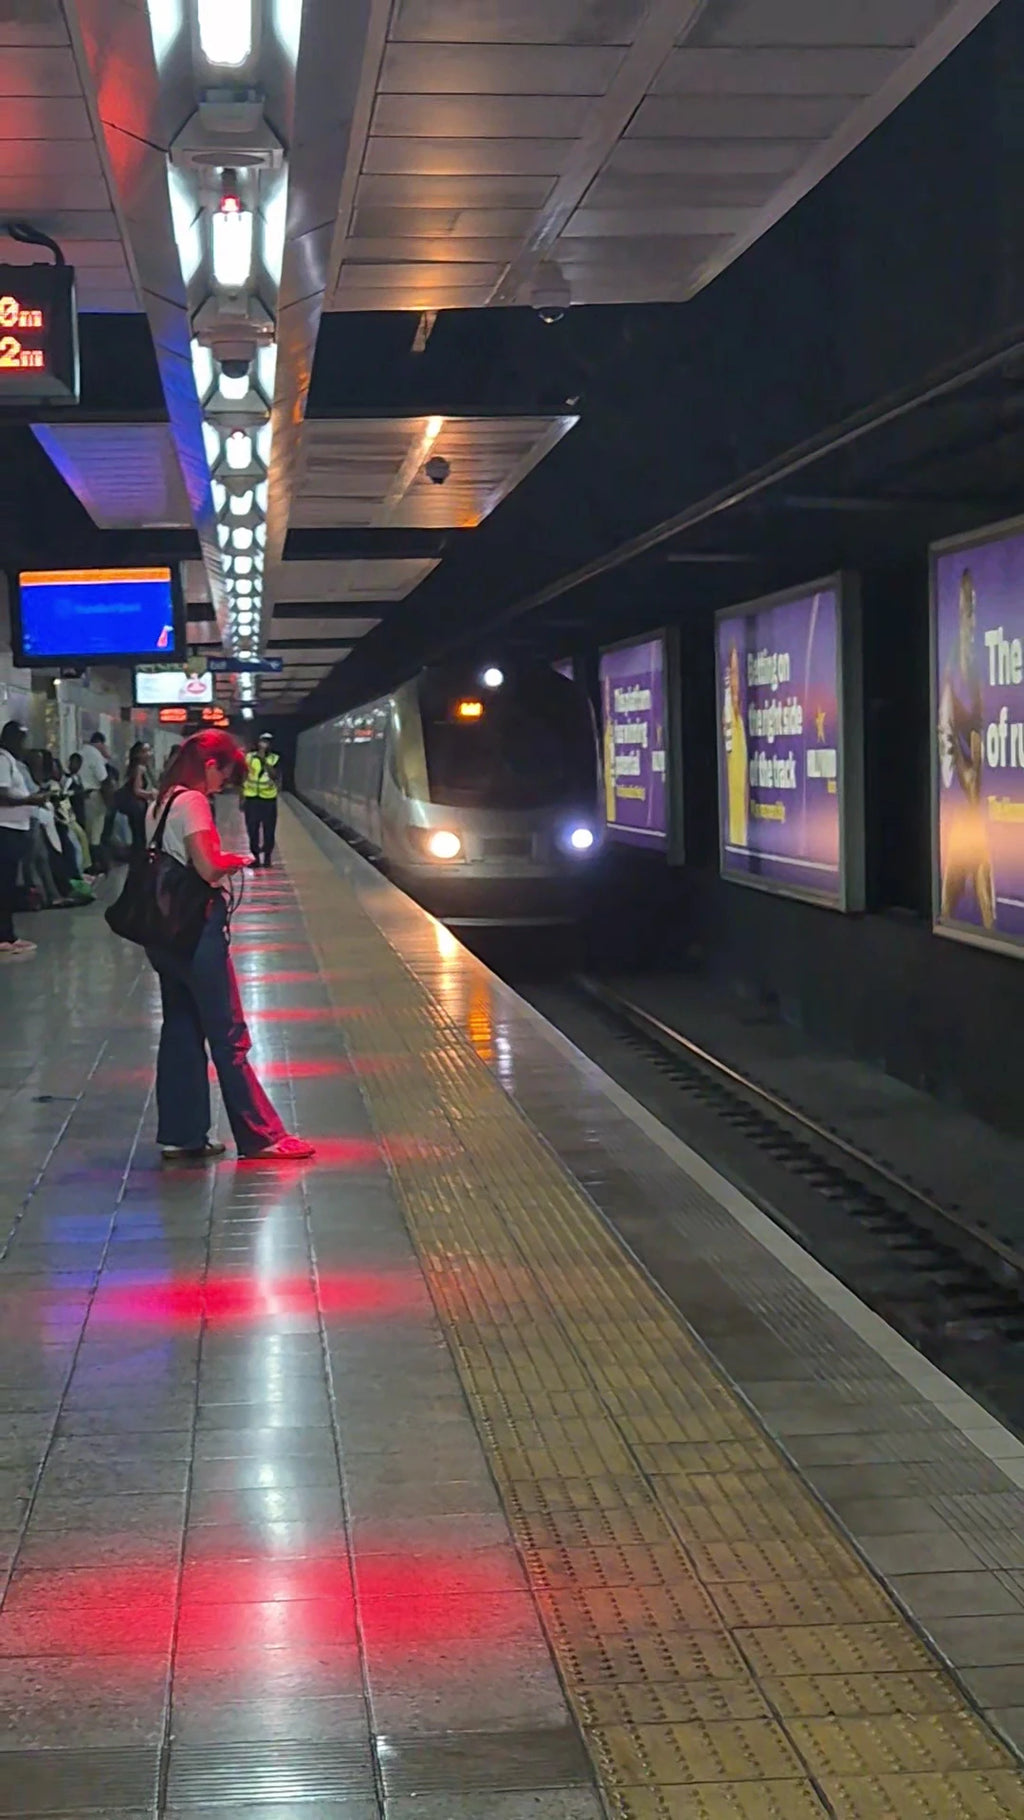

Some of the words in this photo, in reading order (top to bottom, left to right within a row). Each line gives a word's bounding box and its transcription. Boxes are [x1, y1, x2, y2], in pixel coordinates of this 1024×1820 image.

[778, 652, 790, 683] on
[984, 626, 1023, 686] The
[748, 701, 762, 737] the
[762, 698, 782, 743] right
[783, 696, 803, 735] side
[986, 706, 1008, 768] of
[759, 751, 773, 788] the
[773, 751, 797, 789] track
